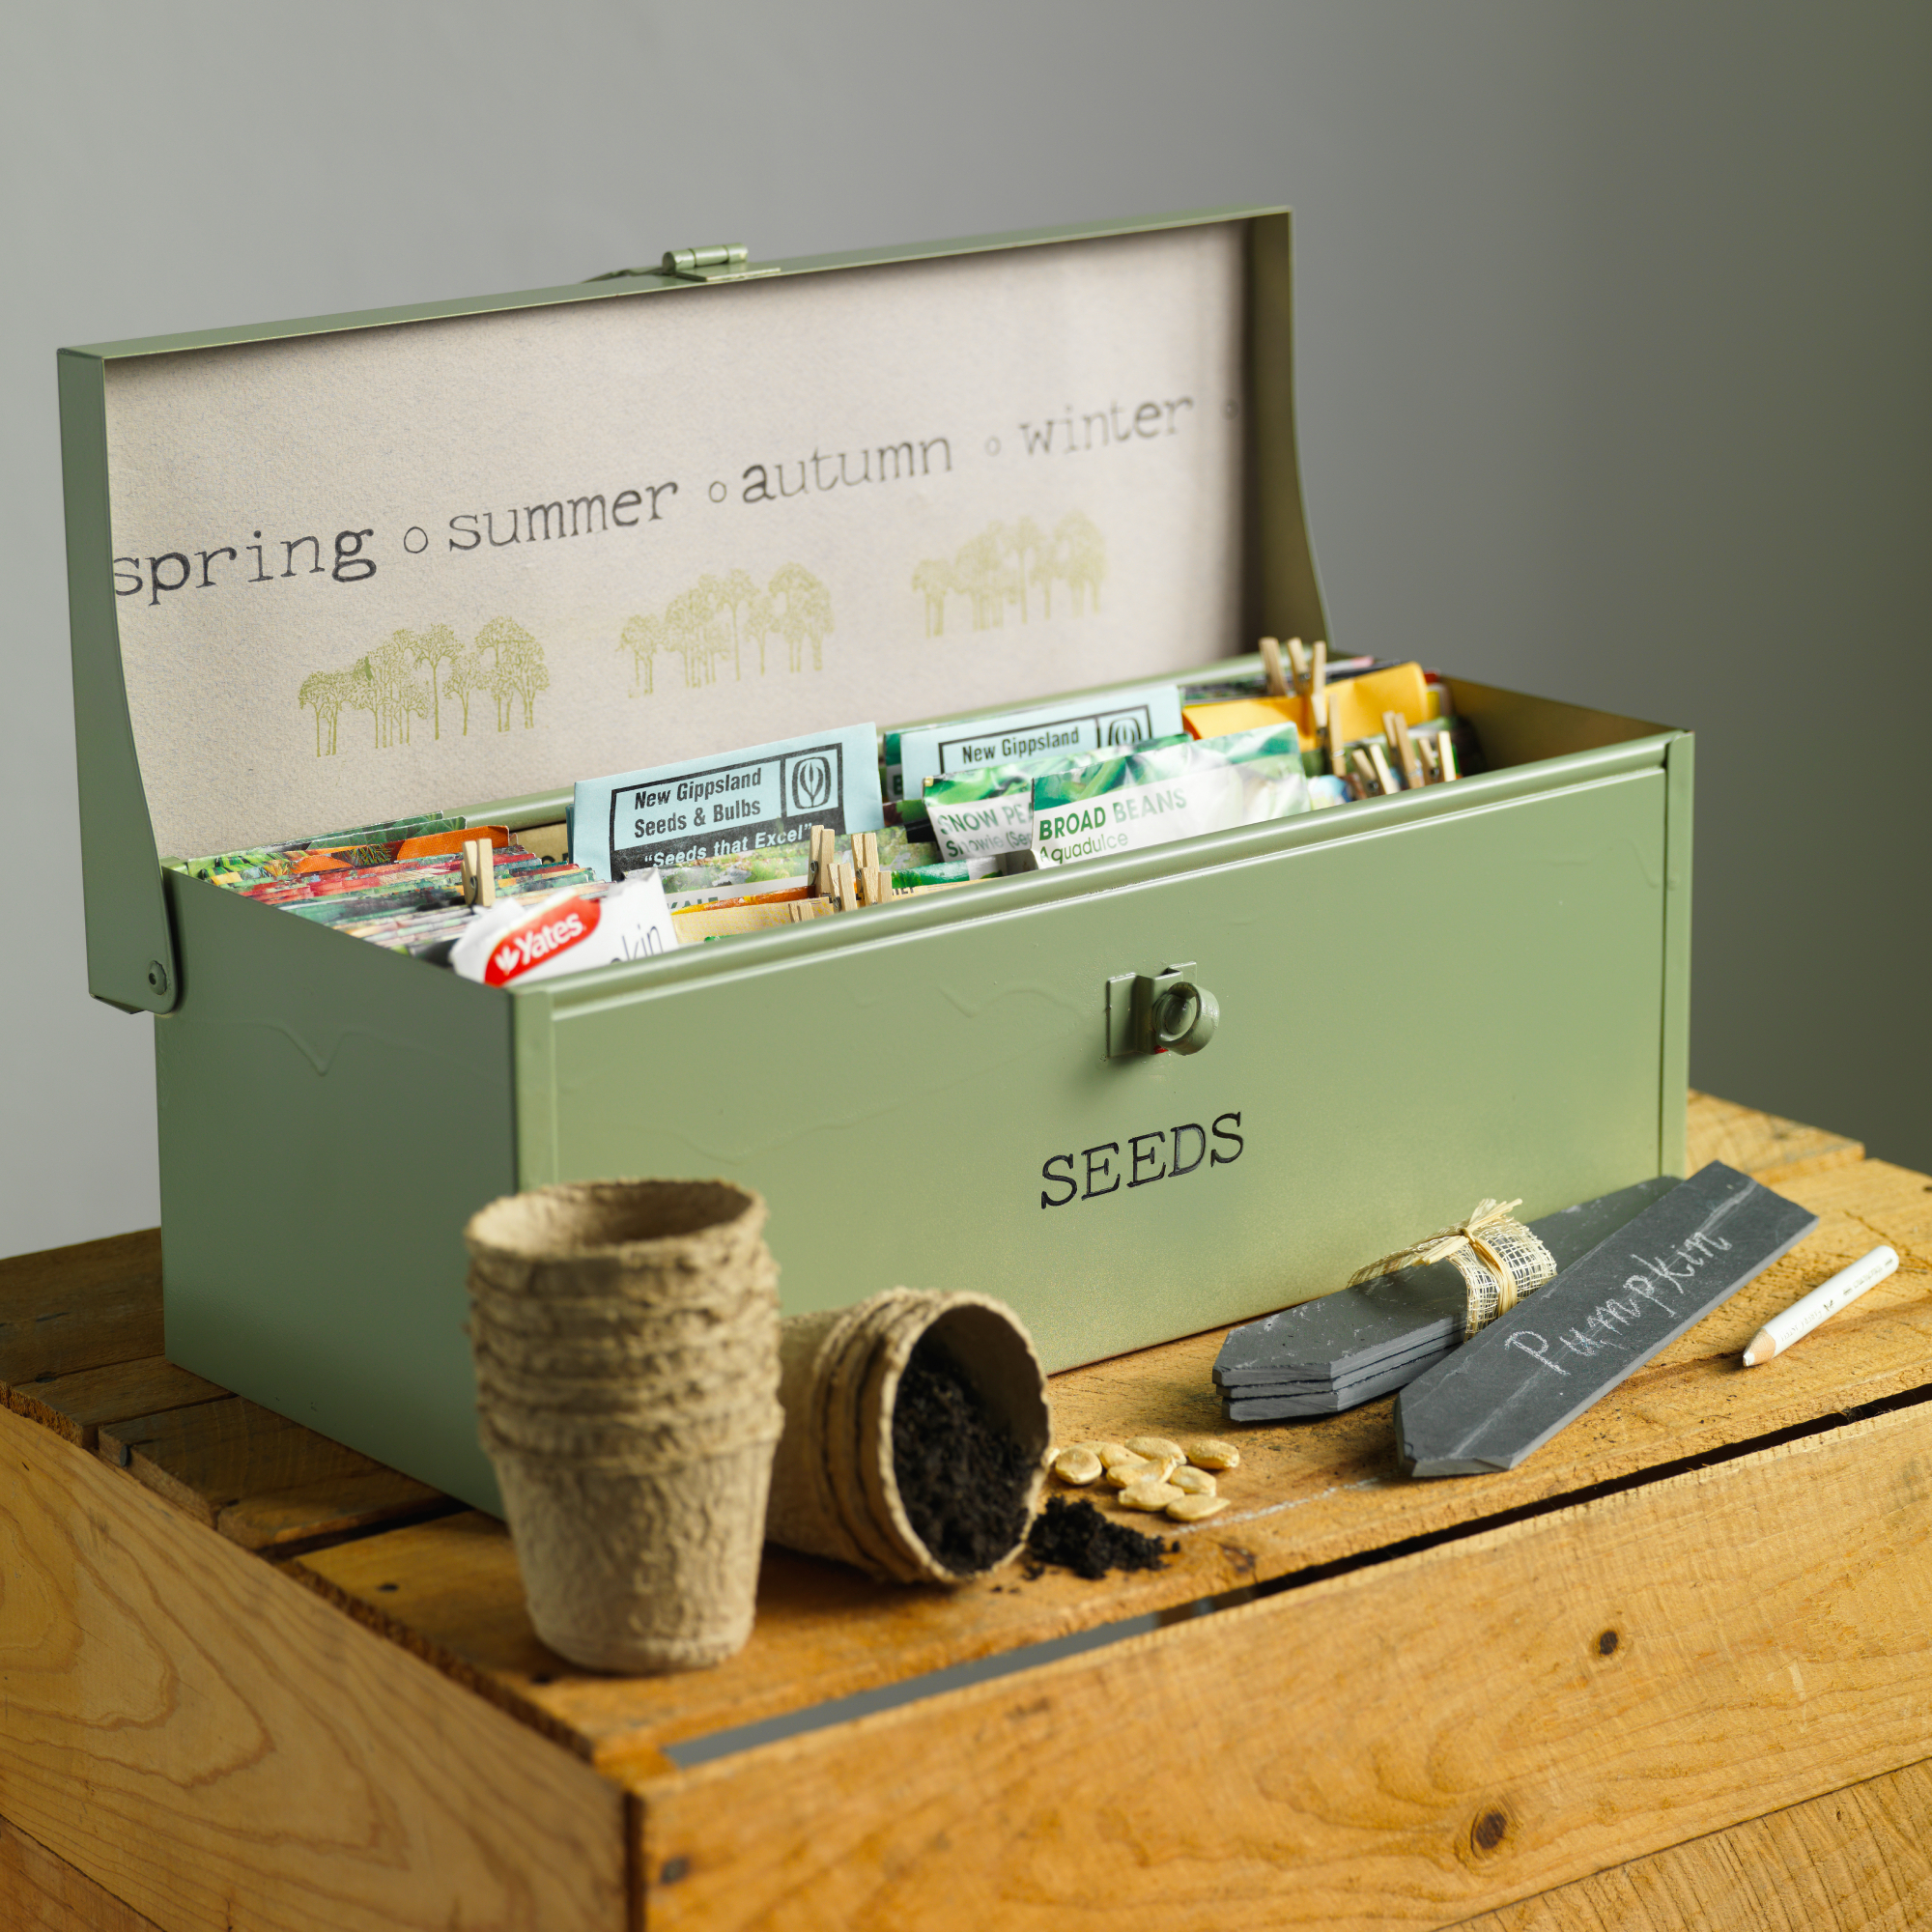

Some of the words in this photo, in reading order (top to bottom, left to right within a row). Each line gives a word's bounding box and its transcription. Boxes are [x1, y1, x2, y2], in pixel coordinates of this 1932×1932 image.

[113, 527, 377, 607] spring
[448, 480, 678, 552] summer
[742, 437, 952, 503] autumn
[1017, 395, 1194, 457] winter
[961, 746, 996, 764] New
[1002, 726, 1079, 758] Gippsland
[634, 789, 671, 810] New
[676, 768, 762, 802] Gippsland
[634, 812, 687, 838] Seeds
[694, 807, 706, 827] &
[713, 799, 761, 823] Bulbs
[937, 806, 998, 835] SNOW
[1038, 807, 1106, 840] BROAD
[1113, 788, 1187, 823] BEANS
[714, 837, 749, 856] that
[946, 835, 1005, 858] Snowie
[1039, 833, 1128, 865] Aquadulce
[514, 913, 583, 965] Yates
[1040, 1111, 1244, 1209] SEEDS
[1504, 1232, 1733, 1377] Pumpkin
